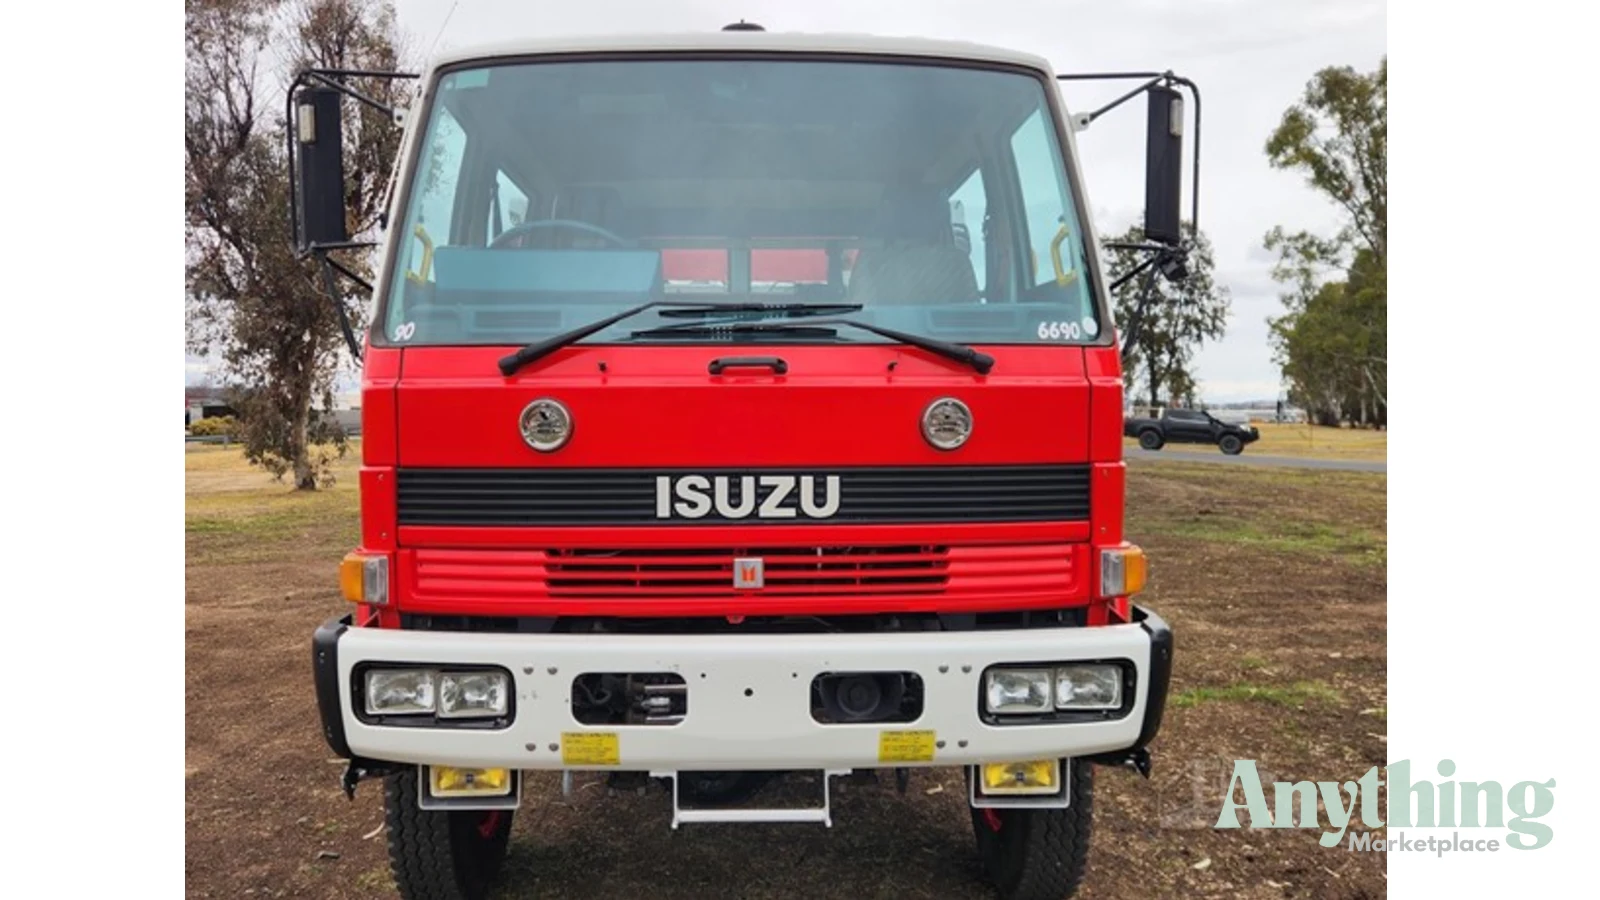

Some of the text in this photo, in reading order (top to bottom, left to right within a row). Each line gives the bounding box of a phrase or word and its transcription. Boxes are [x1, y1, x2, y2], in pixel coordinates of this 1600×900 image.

[393, 321, 415, 342] 90
[1038, 321, 1080, 340] 6690
[656, 475, 840, 518] ISUZU
